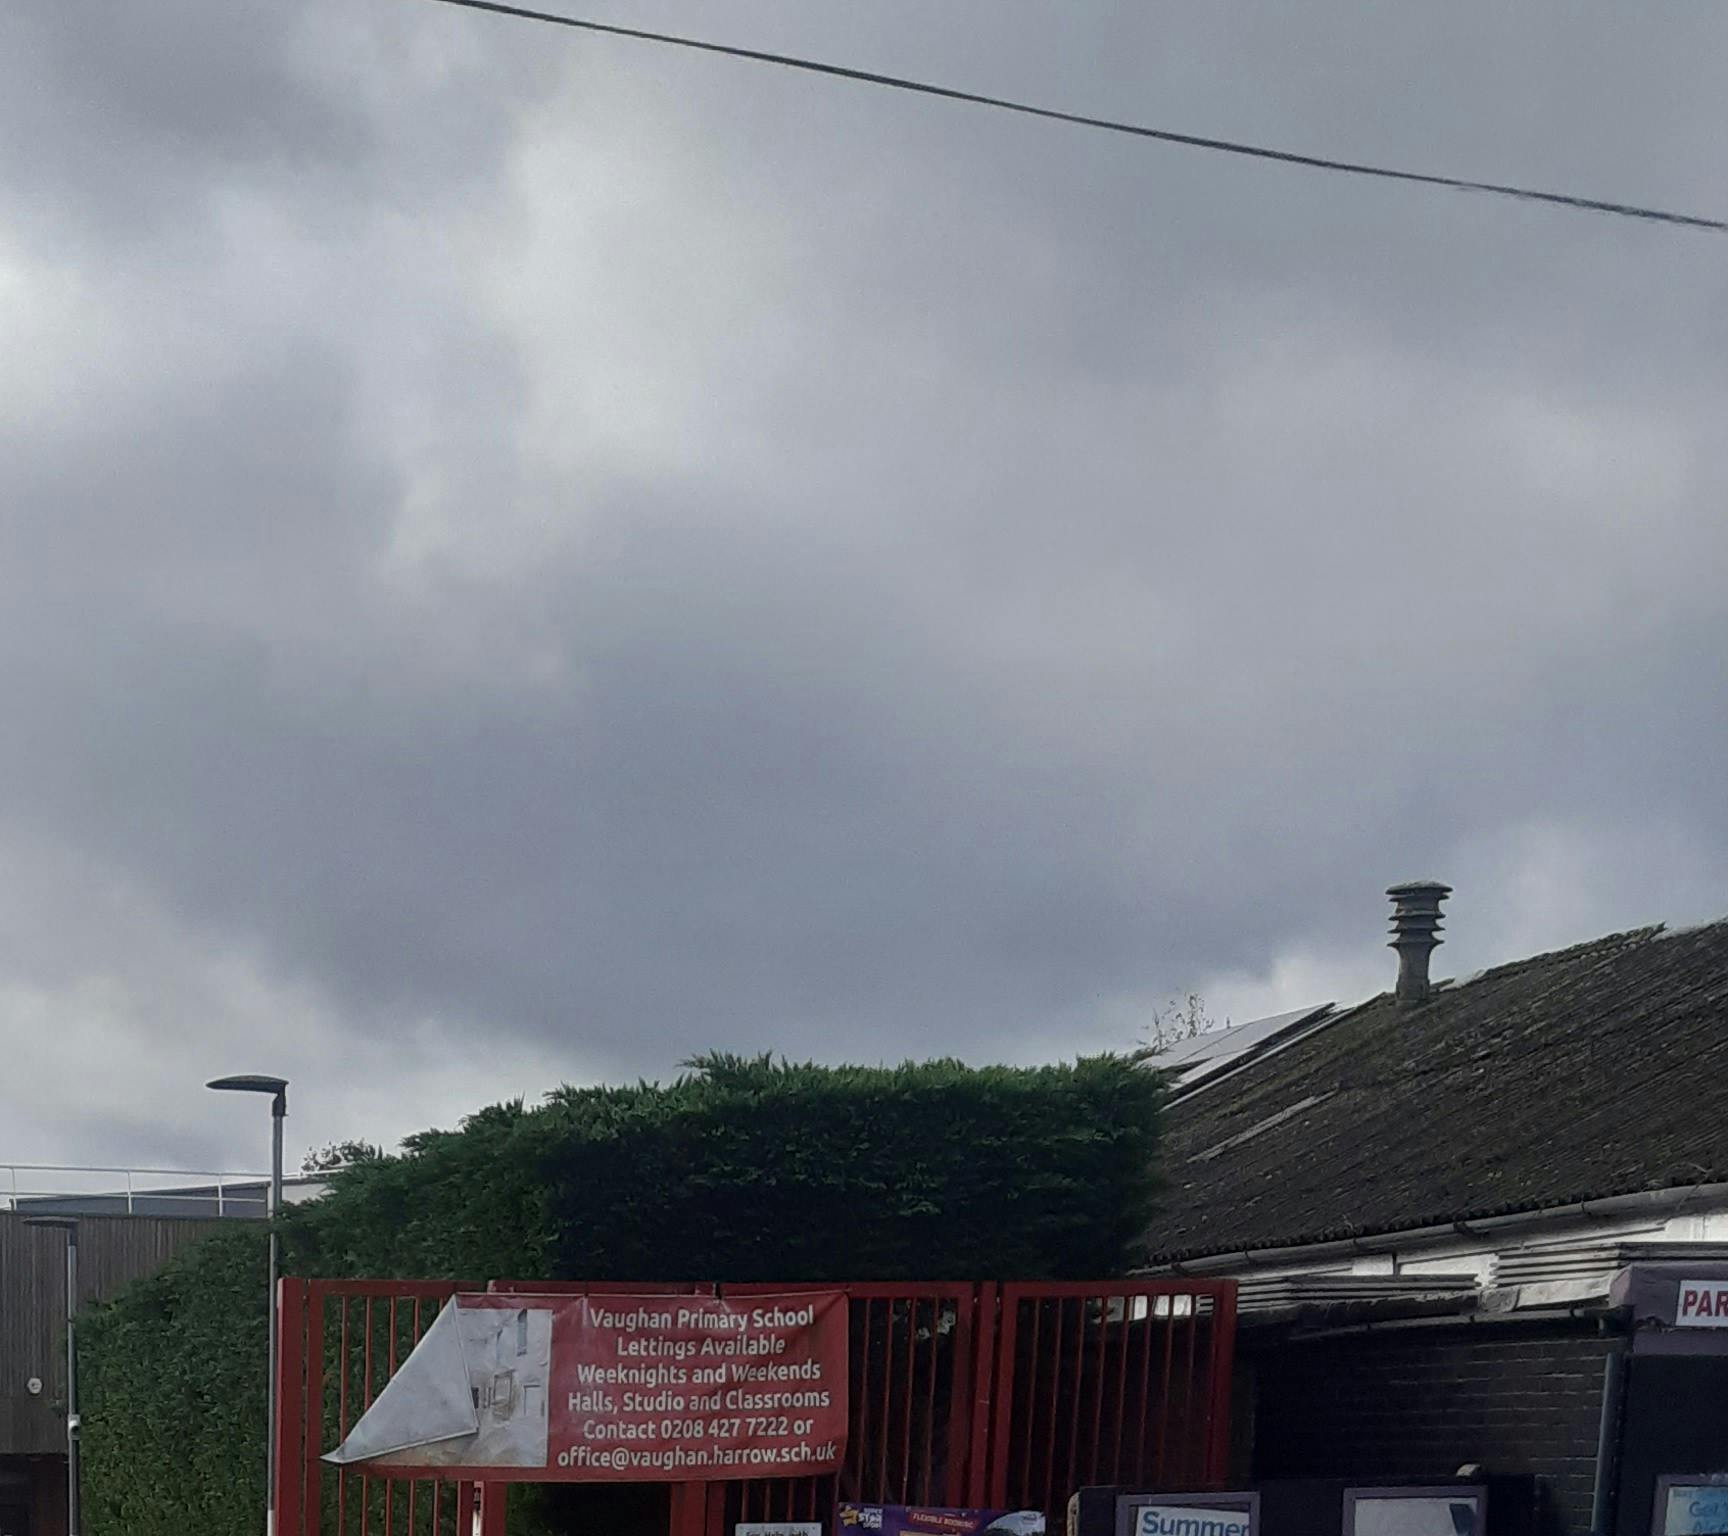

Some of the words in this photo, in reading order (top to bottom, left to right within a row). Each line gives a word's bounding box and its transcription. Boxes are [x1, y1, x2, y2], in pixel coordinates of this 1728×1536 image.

[1681, 1290, 1728, 1317] PAR
[590, 1309, 672, 1331] Vaughan
[677, 1307, 747, 1331] Primary
[753, 1305, 814, 1329] School
[617, 1337, 695, 1359] Lettings
[700, 1334, 785, 1356] Available
[577, 1364, 687, 1388] Weeknights
[692, 1363, 726, 1384] and
[731, 1359, 821, 1382] Weekends
[568, 1392, 618, 1414] Halls,
[622, 1391, 684, 1412] Studio
[689, 1390, 721, 1411] and
[726, 1389, 830, 1410] Classrooms
[583, 1420, 656, 1439] Contact
[660, 1420, 704, 1439] 0208
[708, 1419, 740, 1438] 427
[746, 1418, 788, 1436] 7222
[793, 1420, 814, 1434] or
[557, 1442, 836, 1470] office@vaughan.harrow.sch.uk
